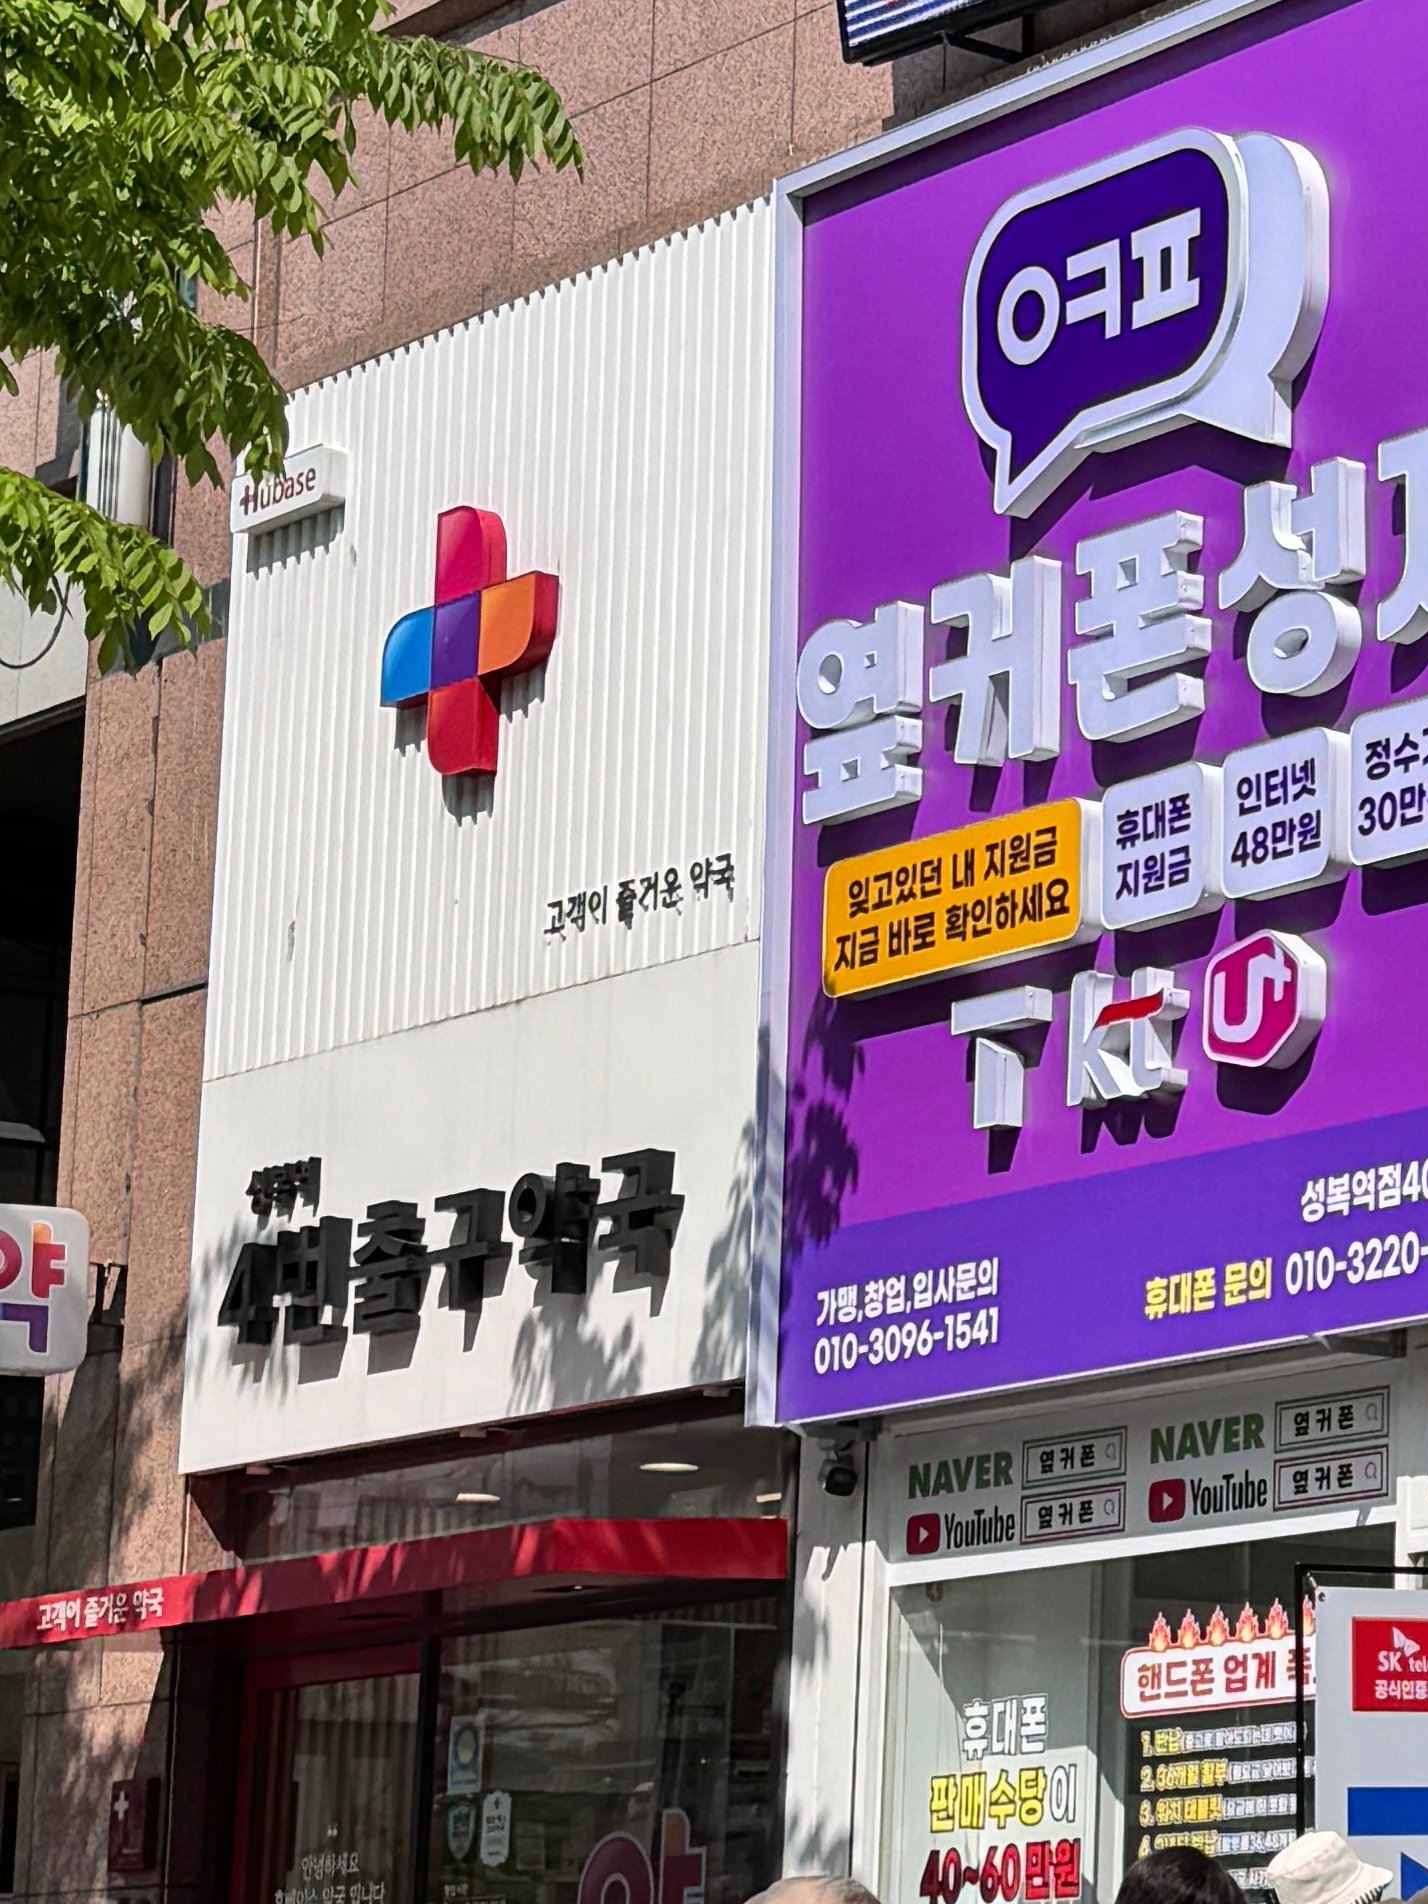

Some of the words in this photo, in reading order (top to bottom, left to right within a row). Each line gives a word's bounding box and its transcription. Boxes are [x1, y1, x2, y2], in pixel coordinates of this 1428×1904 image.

[239, 467, 317, 517] Hubase
[1236, 757, 1318, 817] 인터넷
[1115, 792, 1193, 851] 휴대폰
[1230, 809, 1323, 868] 48만원
[543, 884, 608, 934] 고객이
[615, 867, 683, 926] 즐거운
[689, 852, 735, 901] 약국
[848, 856, 943, 920] 잊고있던
[951, 846, 976, 890] 내
[983, 824, 1058, 880] 지원금
[1115, 844, 1193, 901] 지원금
[833, 924, 880, 973] 지금
[888, 905, 936, 958] 바로
[945, 876, 1071, 943] 확인하세요
[1065, 965, 1190, 1109] kt
[815, 1256, 1000, 1328] 가맹,창업,입사문의
[1143, 1265, 1217, 1321] 휴대폰
[1223, 1256, 1273, 1308] 문의
[813, 1306, 1000, 1376] 010-3096-1541
[1149, 1411, 1266, 1465] NAVER
[907, 1449, 1014, 1500] NAVER
[1190, 1470, 1269, 1516] YouTube
[943, 1508, 1017, 1552] YouTube
[36, 1597, 81, 1632] 고객이
[84, 1592, 128, 1628] 즐거운
[132, 1586, 165, 1621] 약국
[1137, 1657, 1216, 1704] 핸드폰
[1223, 1650, 1277, 1694] 업계
[1377, 1650, 1402, 1673] SK
[961, 1693, 1049, 1761] 휴대폰
[928, 1763, 1078, 1834] 판매수당이
[301, 1851, 360, 1881] 안녕하세요
